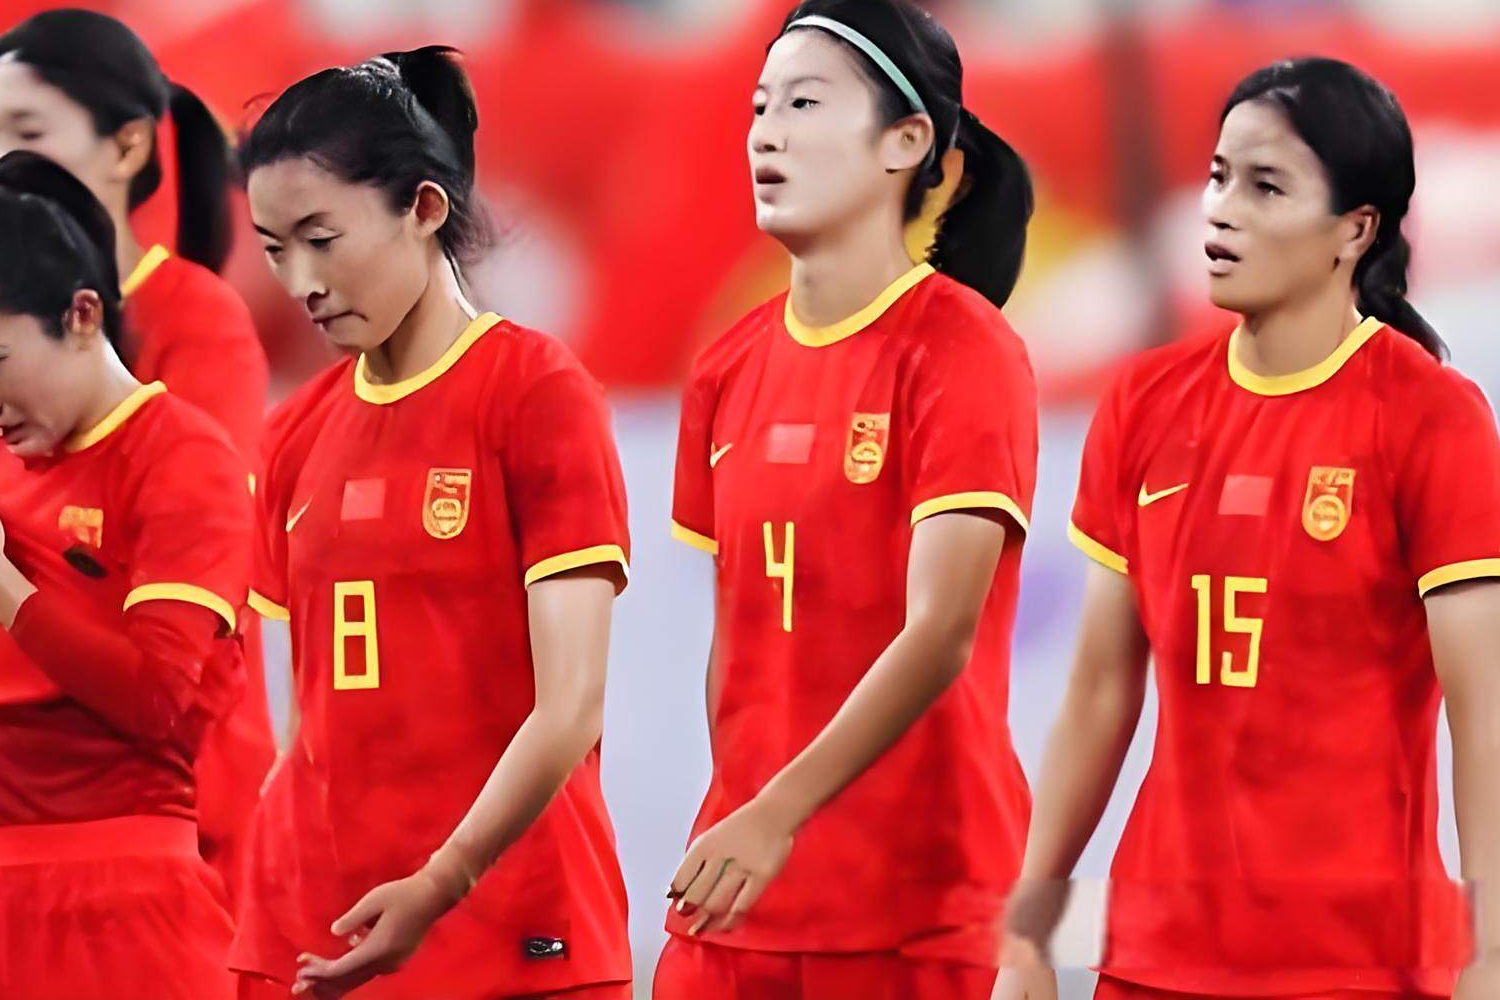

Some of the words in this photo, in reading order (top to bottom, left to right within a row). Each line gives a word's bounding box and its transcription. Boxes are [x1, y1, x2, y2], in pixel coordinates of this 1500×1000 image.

[762, 521, 795, 633] 4
[1191, 574, 1268, 688] 15
[333, 580, 380, 690] 8
